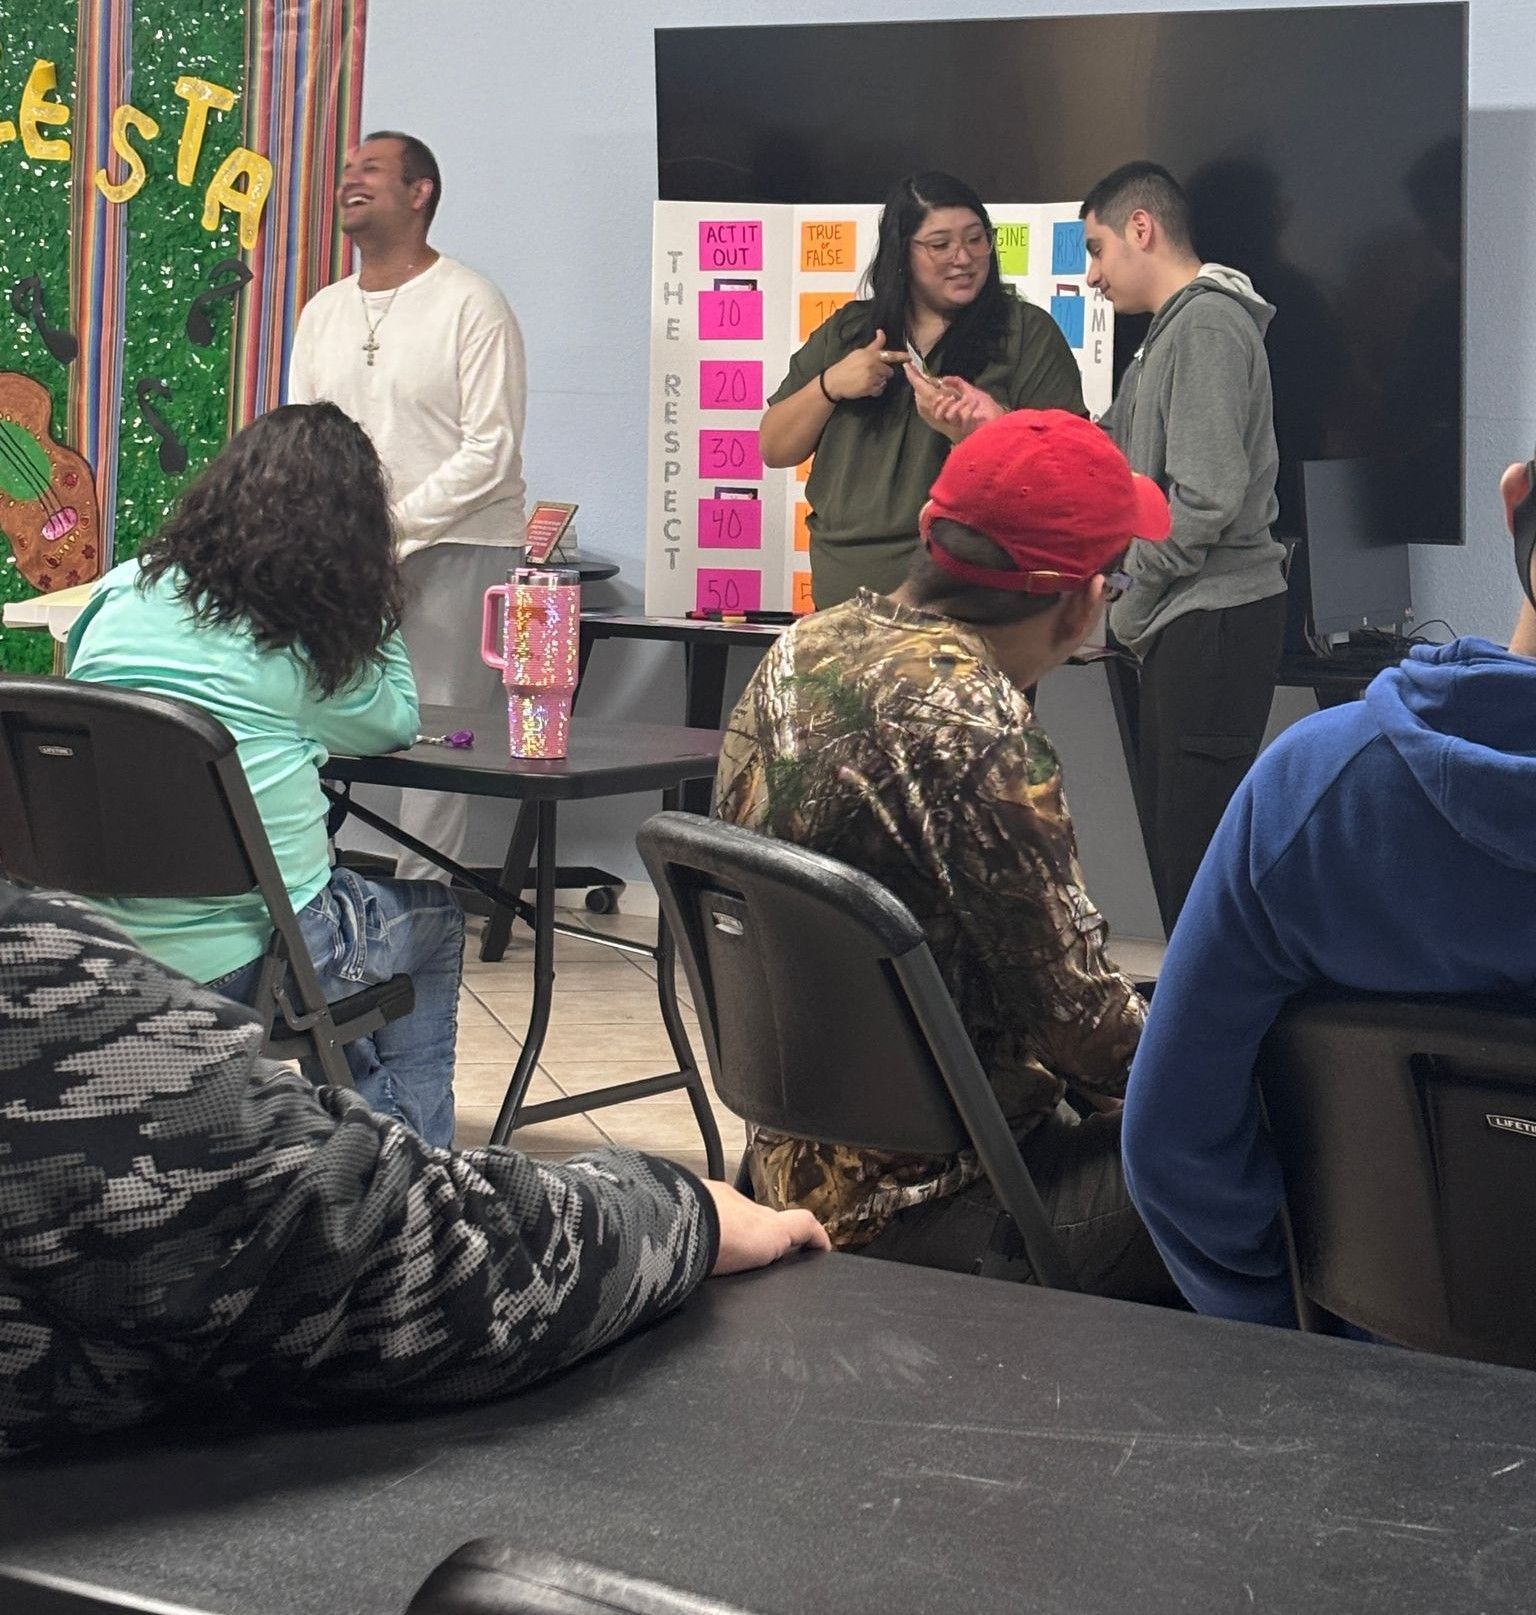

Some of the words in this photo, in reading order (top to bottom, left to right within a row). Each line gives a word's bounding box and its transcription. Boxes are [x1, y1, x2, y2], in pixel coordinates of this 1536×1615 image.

[0, 59, 273, 250] ESTA
[706, 225, 737, 243] ACT
[742, 225, 758, 242] IT
[807, 224, 842, 240] TRUE
[997, 226, 1028, 247] GINE
[713, 248, 749, 266] OUT
[806, 250, 844, 266] FALSE
[664, 251, 684, 341] THE
[718, 299, 741, 327] 10
[1091, 287, 1106, 364] AME
[715, 369, 747, 403] 20
[712, 438, 745, 468] 30
[662, 373, 682, 570] RESPECT
[712, 508, 742, 539] 40
[708, 579, 740, 610] 50
[1496, 1118, 1536, 1134] LIFETI
